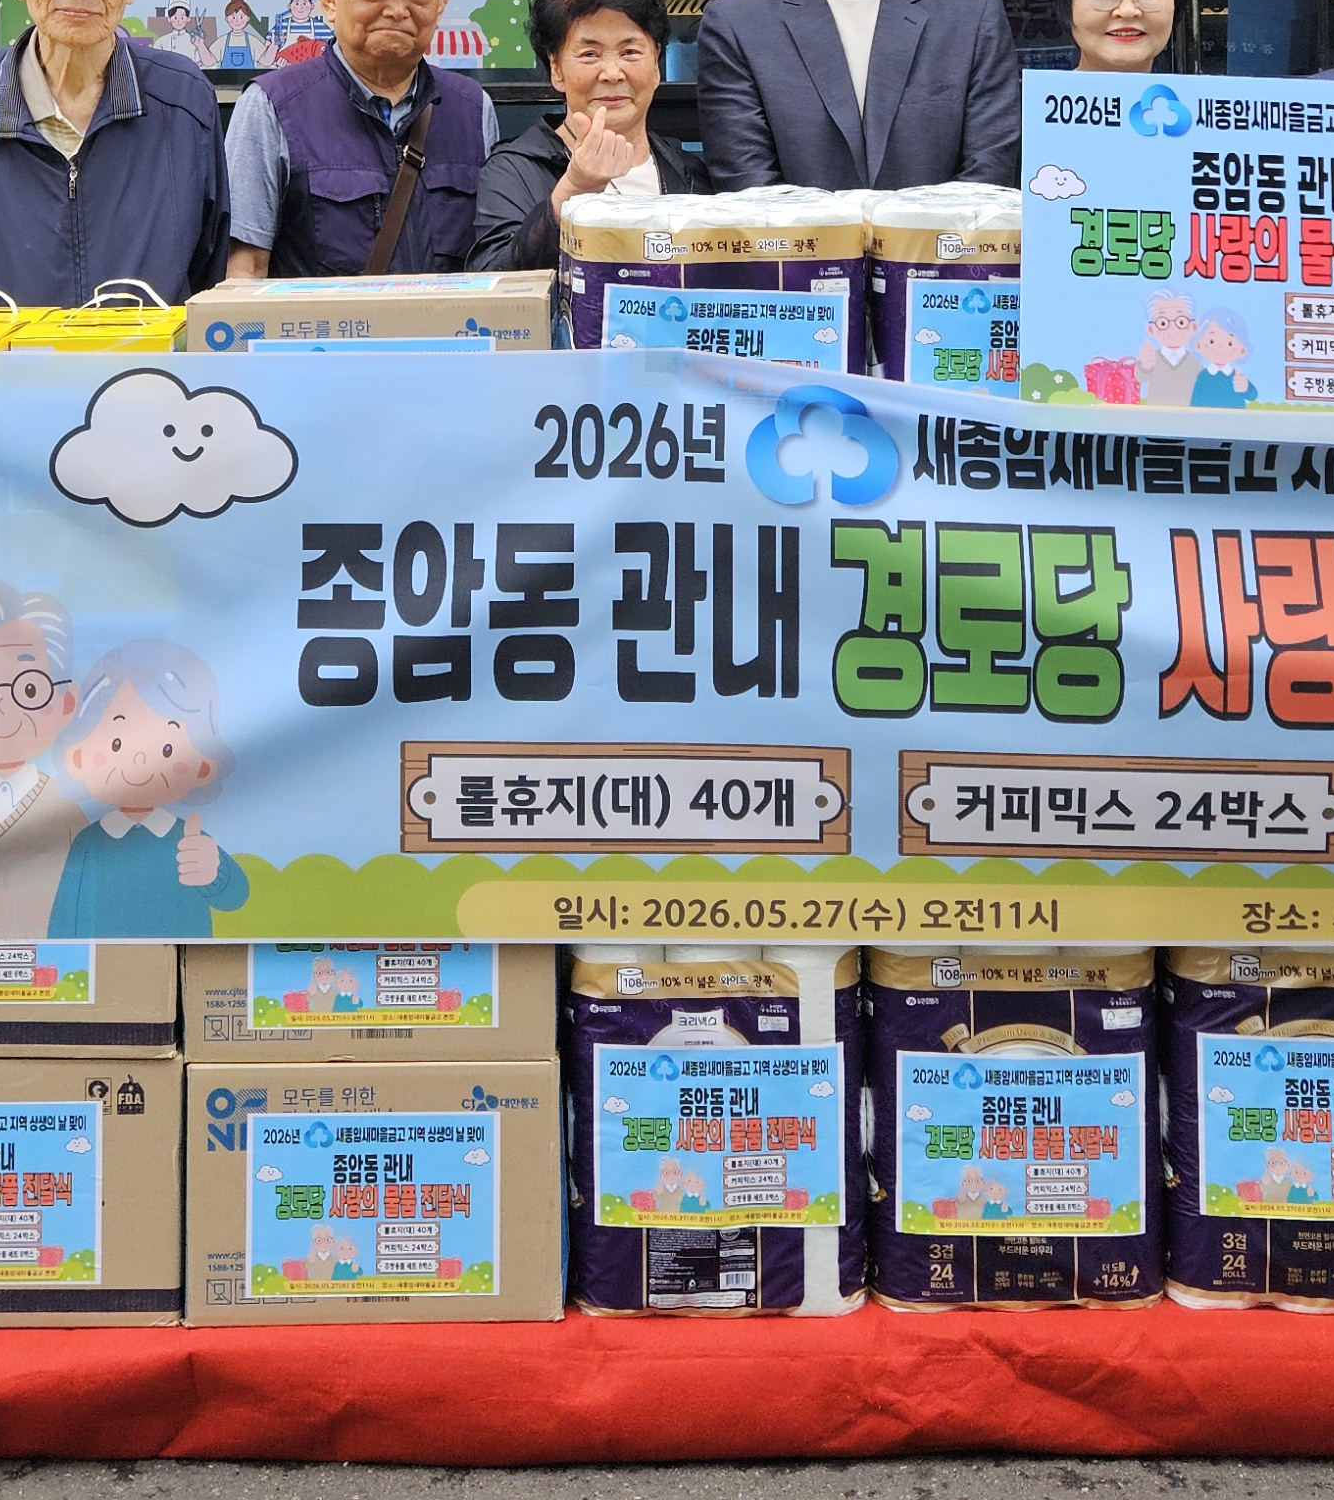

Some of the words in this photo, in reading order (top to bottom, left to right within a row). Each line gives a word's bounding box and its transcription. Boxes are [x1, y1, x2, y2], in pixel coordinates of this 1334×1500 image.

[1044, 94, 1121, 128] 2026년
[1190, 150, 1289, 214] 종암동
[650, 240, 688, 255] 108mm
[691, 240, 713, 253] 10%
[717, 239, 727, 253] 더
[730, 239, 753, 254] 넓은
[756, 237, 790, 252] 와이드
[793, 237, 817, 253] 광폭
[1071, 208, 1175, 278] 경로당
[1184, 213, 1288, 282] 사랑의
[534, 401, 726, 484] 2026년
[297, 520, 580, 707] 종암동
[611, 521, 800, 704] 관내
[829, 516, 1135, 720] 경로당
[455, 773, 671, 829] 롤휴지(대)
[689, 777, 795, 827] 40개
[955, 784, 1136, 835] 커피믹스
[1154, 790, 1309, 839] 24박스
[553, 895, 629, 931] 일시:
[642, 897, 906, 932] 2026.05.27(수)
[919, 898, 1058, 933] 오전11시
[1242, 901, 1320, 934] 장소:
[281, 1087, 335, 1107] 모두를
[342, 1087, 376, 1107] 위한
[929, 1243, 954, 1260] 3겹
[930, 1263, 954, 1281] 24
[930, 1281, 955, 1289] ROLLS
